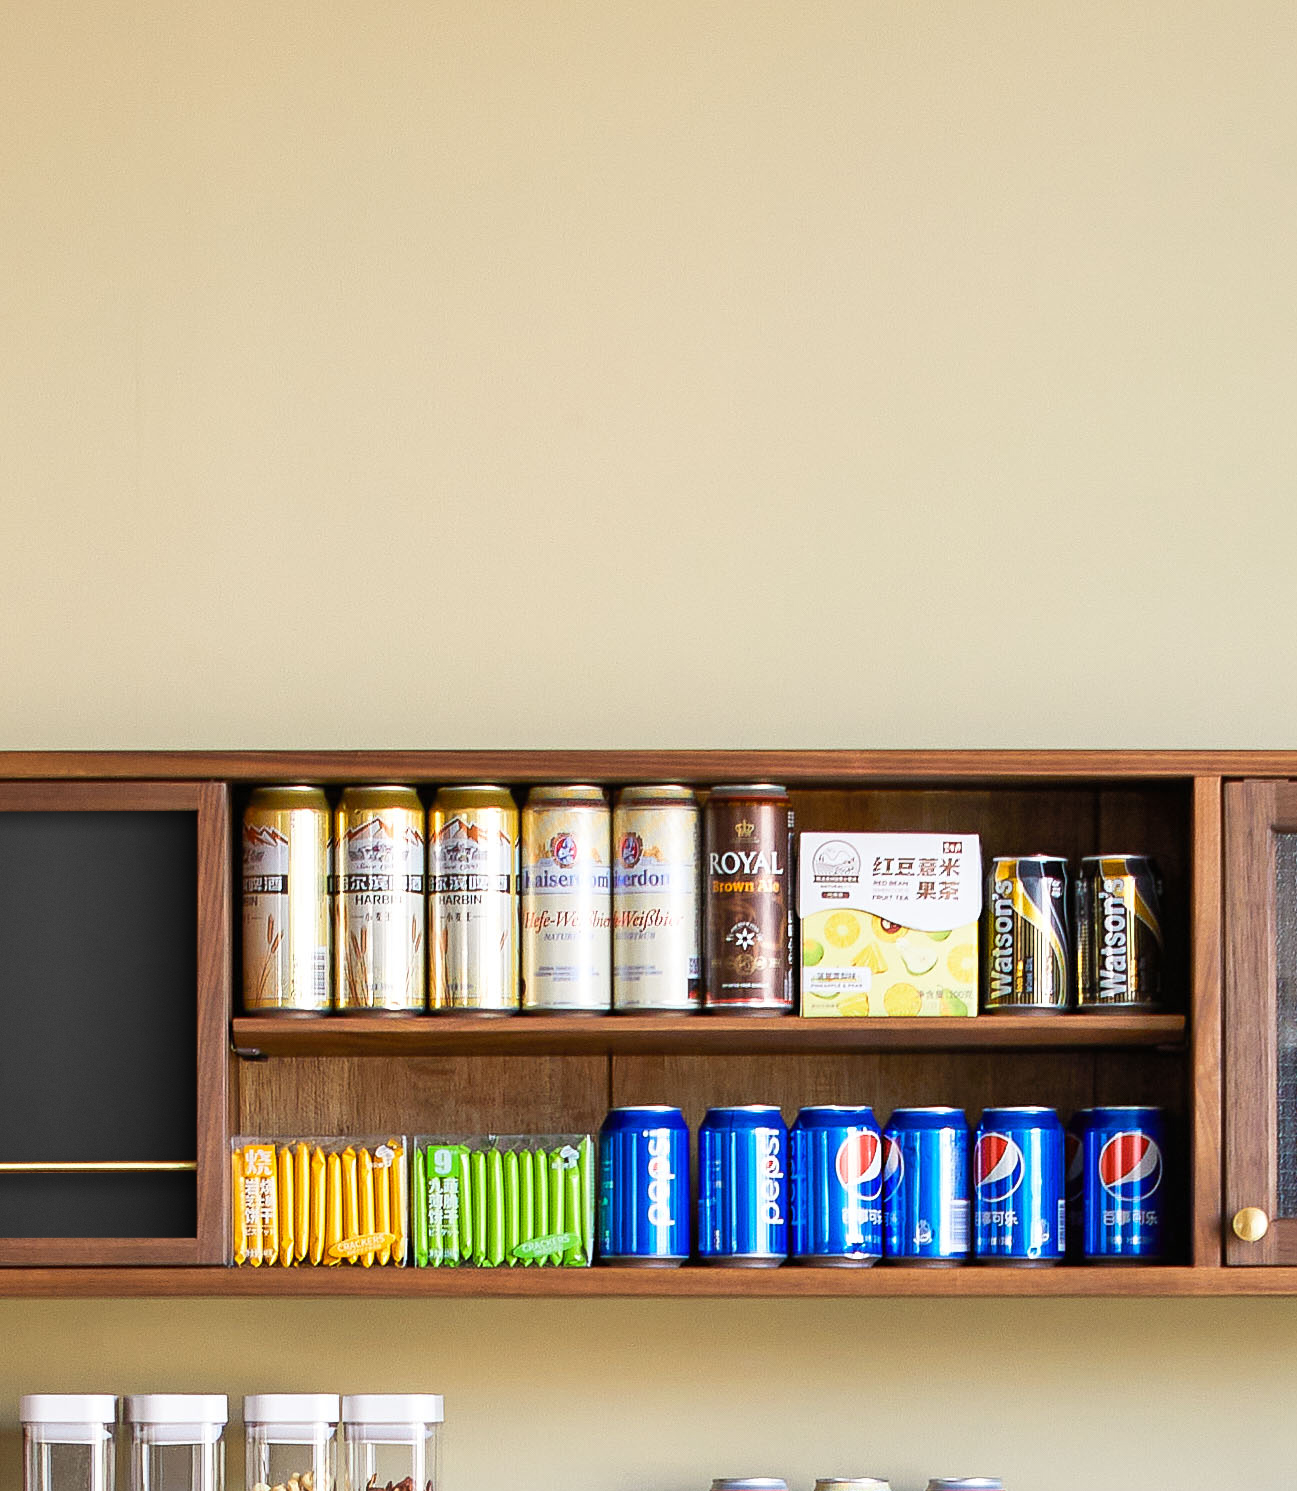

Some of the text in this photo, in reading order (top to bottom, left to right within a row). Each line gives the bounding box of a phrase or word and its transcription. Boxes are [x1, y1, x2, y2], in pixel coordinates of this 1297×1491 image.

[709, 851, 784, 875] ROYAL
[872, 857, 960, 877] 红豆薏米
[438, 894, 482, 905] HARBIN
[712, 881, 754, 893] Brown
[916, 881, 959, 900] 果茶
[990, 880, 1014, 999] Watson's
[1099, 878, 1127, 998] Watson's
[245, 1149, 272, 1176] 烧
[432, 1148, 453, 1174] 9
[648, 1129, 675, 1226] pepsi
[761, 1128, 784, 1224] pepsi
